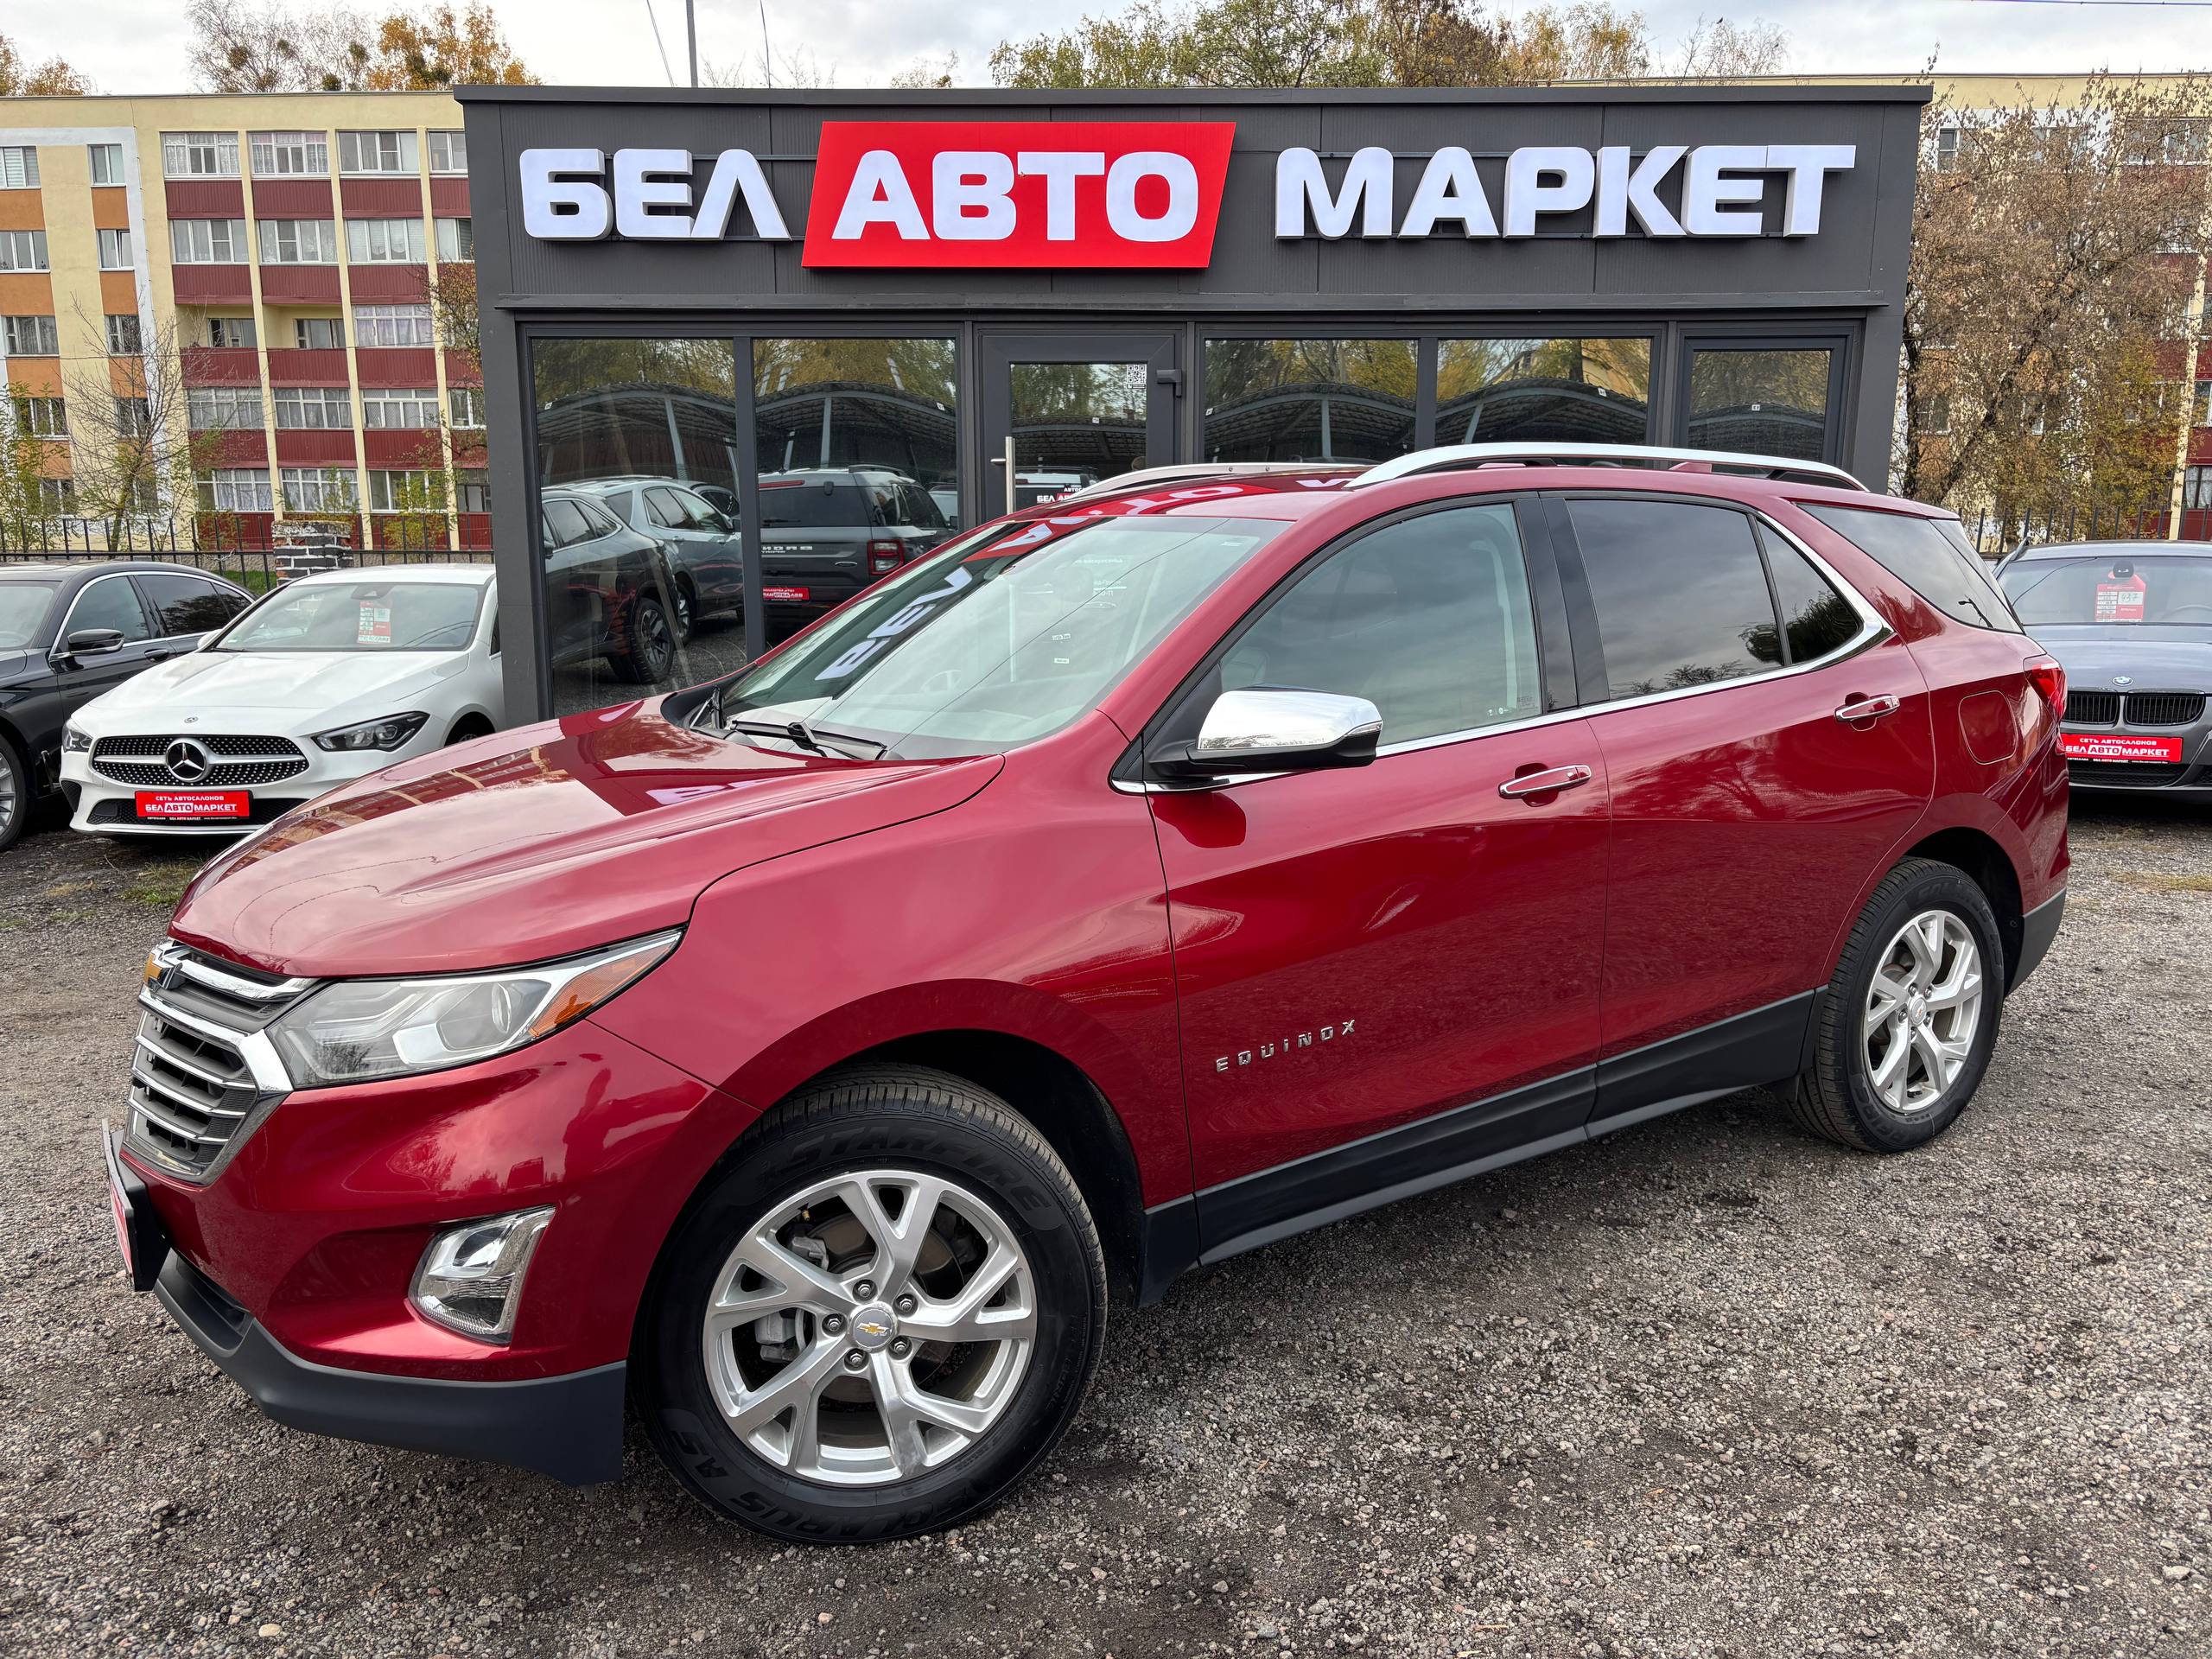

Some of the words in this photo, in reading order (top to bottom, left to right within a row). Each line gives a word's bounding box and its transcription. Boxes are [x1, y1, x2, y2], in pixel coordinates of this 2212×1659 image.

[520, 149, 792, 241] БЕЛ
[831, 150, 1198, 242] АВТО
[1275, 145, 1856, 239] МАРКЕТ
[2089, 746, 2120, 754] АВТО
[2122, 747, 2170, 756] МАРКЕТ
[1216, 1019, 1356, 1072] EQUINOX
[787, 1125, 1052, 1211] STARFIRE
